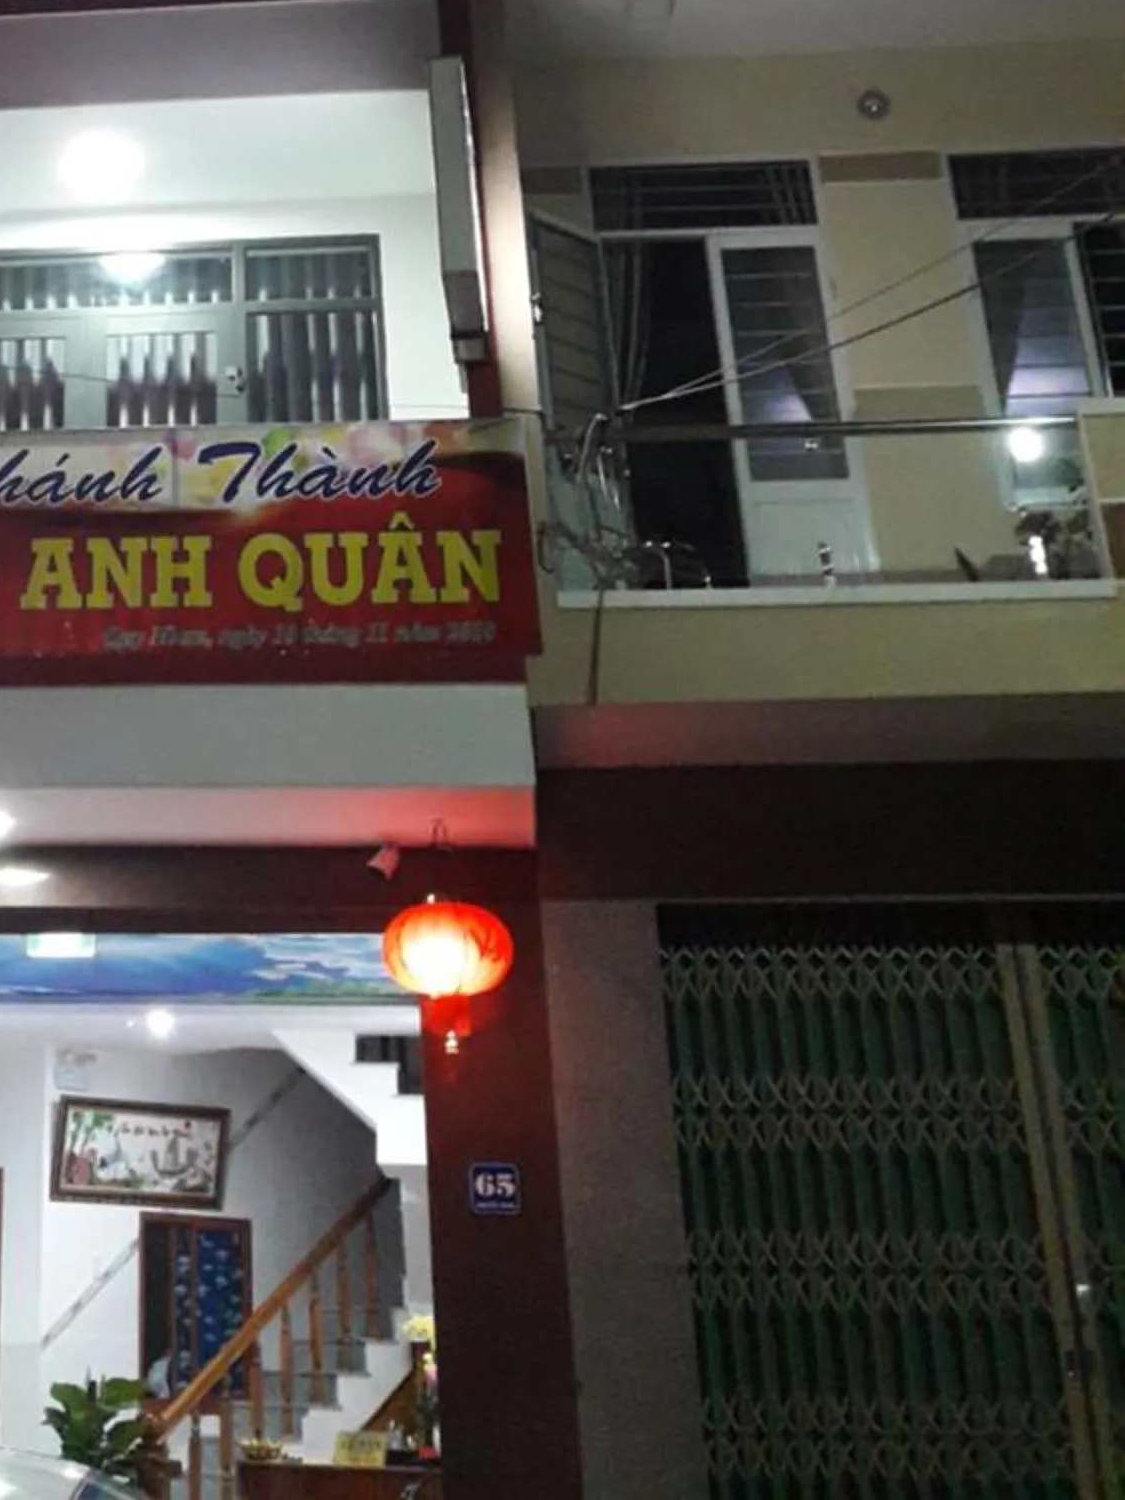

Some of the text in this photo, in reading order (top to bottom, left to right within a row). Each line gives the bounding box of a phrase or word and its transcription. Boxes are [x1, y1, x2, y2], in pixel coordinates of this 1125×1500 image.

[197, 439, 441, 504] Thành
[20, 536, 214, 610] ANH
[237, 510, 503, 612] QUÂN
[476, 1172, 516, 1198] 65
